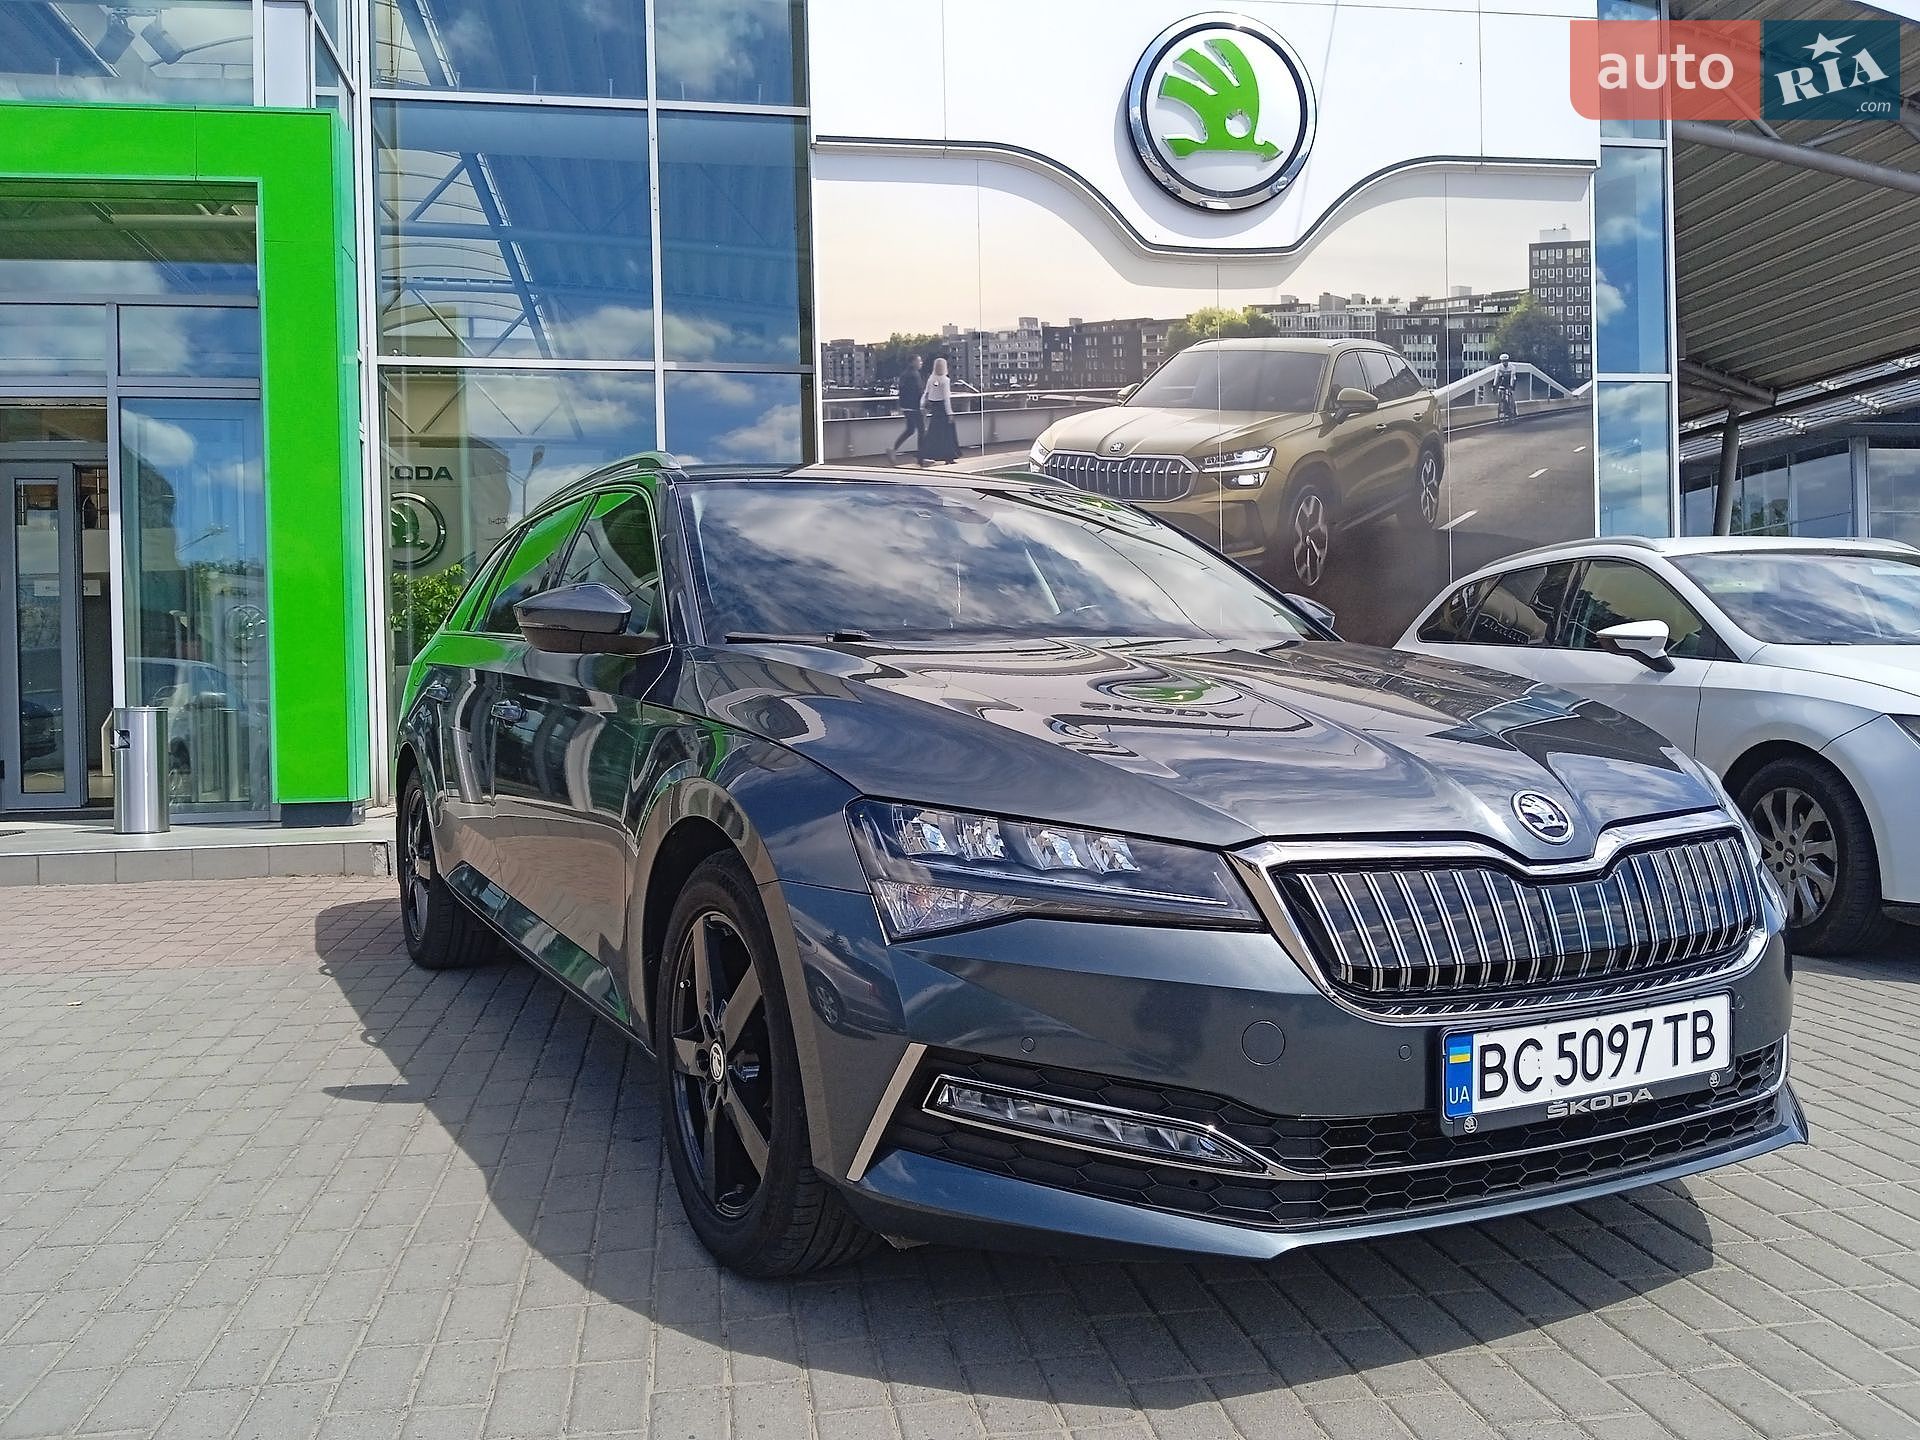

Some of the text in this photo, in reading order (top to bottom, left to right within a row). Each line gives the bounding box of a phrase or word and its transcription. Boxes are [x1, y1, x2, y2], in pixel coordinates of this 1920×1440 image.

[1478, 1009, 1716, 1101] BC 5097 TB
[1449, 1086, 1471, 1105] UA
